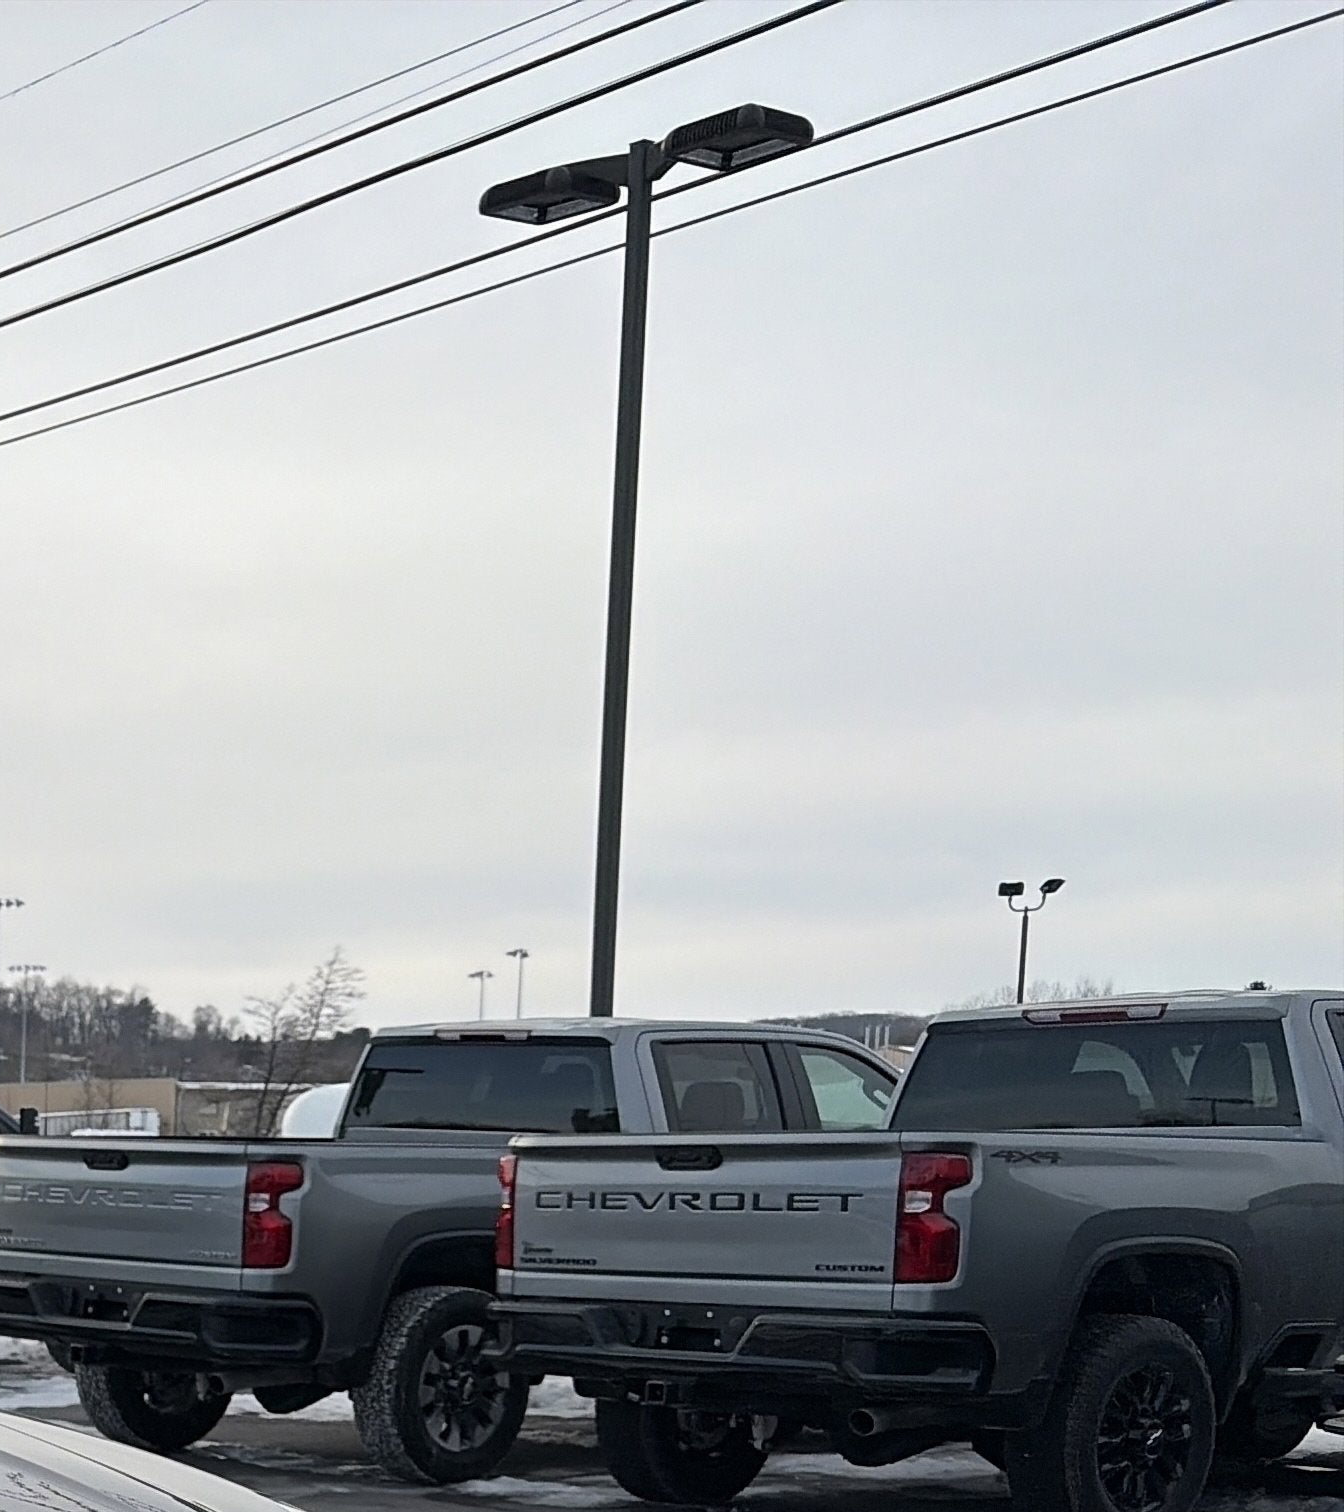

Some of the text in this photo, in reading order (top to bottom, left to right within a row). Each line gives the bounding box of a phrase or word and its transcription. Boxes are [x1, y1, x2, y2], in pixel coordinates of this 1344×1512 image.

[3, 1184, 224, 1212] CHEVROLET
[535, 1190, 864, 1213] CHEVROLET
[814, 1262, 885, 1273] CUSTOM
